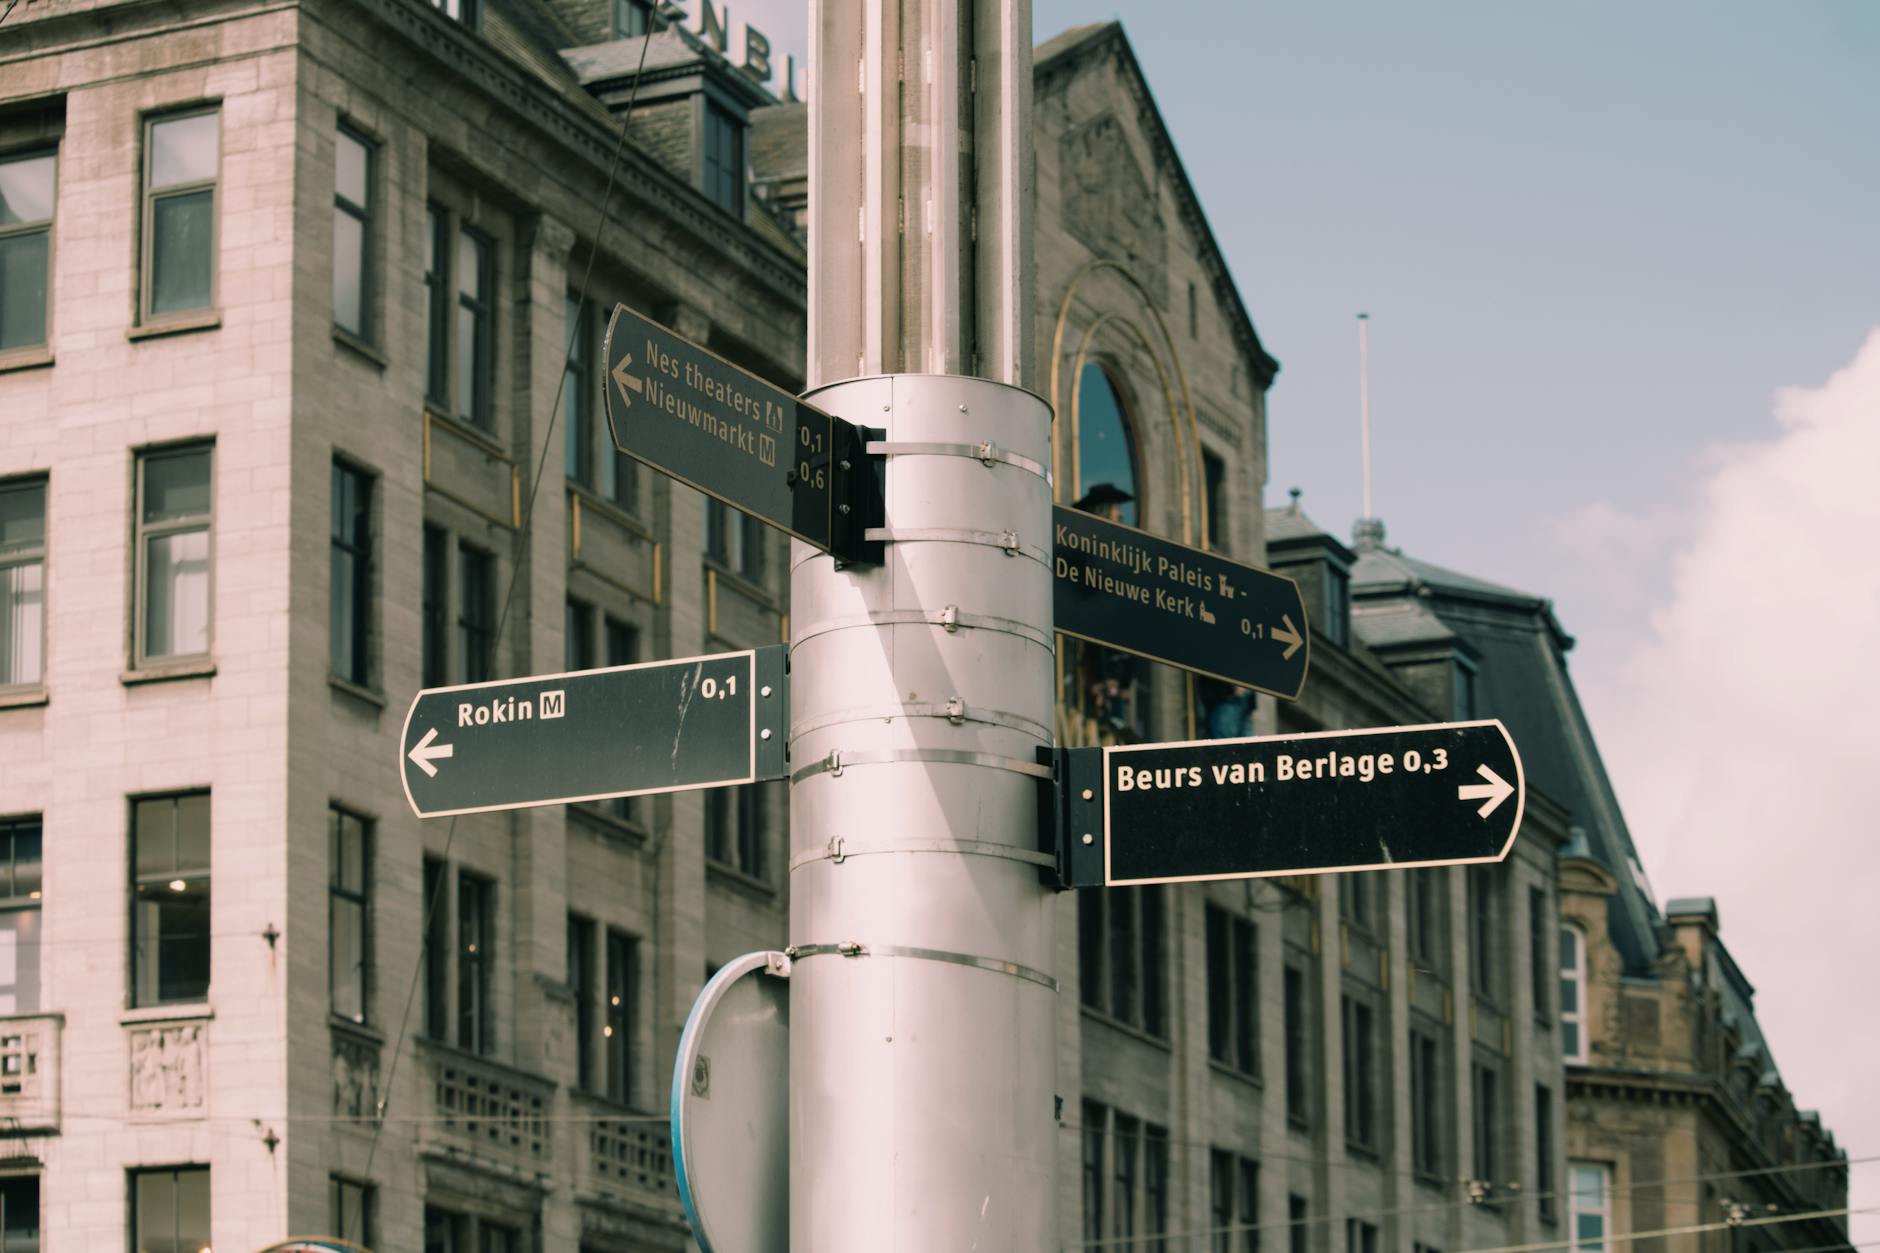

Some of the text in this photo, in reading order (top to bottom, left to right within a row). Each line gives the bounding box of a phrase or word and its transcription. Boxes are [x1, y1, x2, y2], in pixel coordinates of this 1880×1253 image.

[645, 376, 755, 455] Nieuwmarkt
[800, 462, 825, 490] 0,6
[646, 339, 822, 453] Nes theaters 0,1
[1056, 524, 1152, 574] Koninklijk
[1158, 556, 1212, 592] Paleis
[1056, 557, 1264, 640] De Nieuwe Kerk 0,1
[458, 697, 533, 727] Rokin
[701, 675, 737, 700] 0,1
[1117, 748, 1449, 792] Beurs van Berlage 0,3
